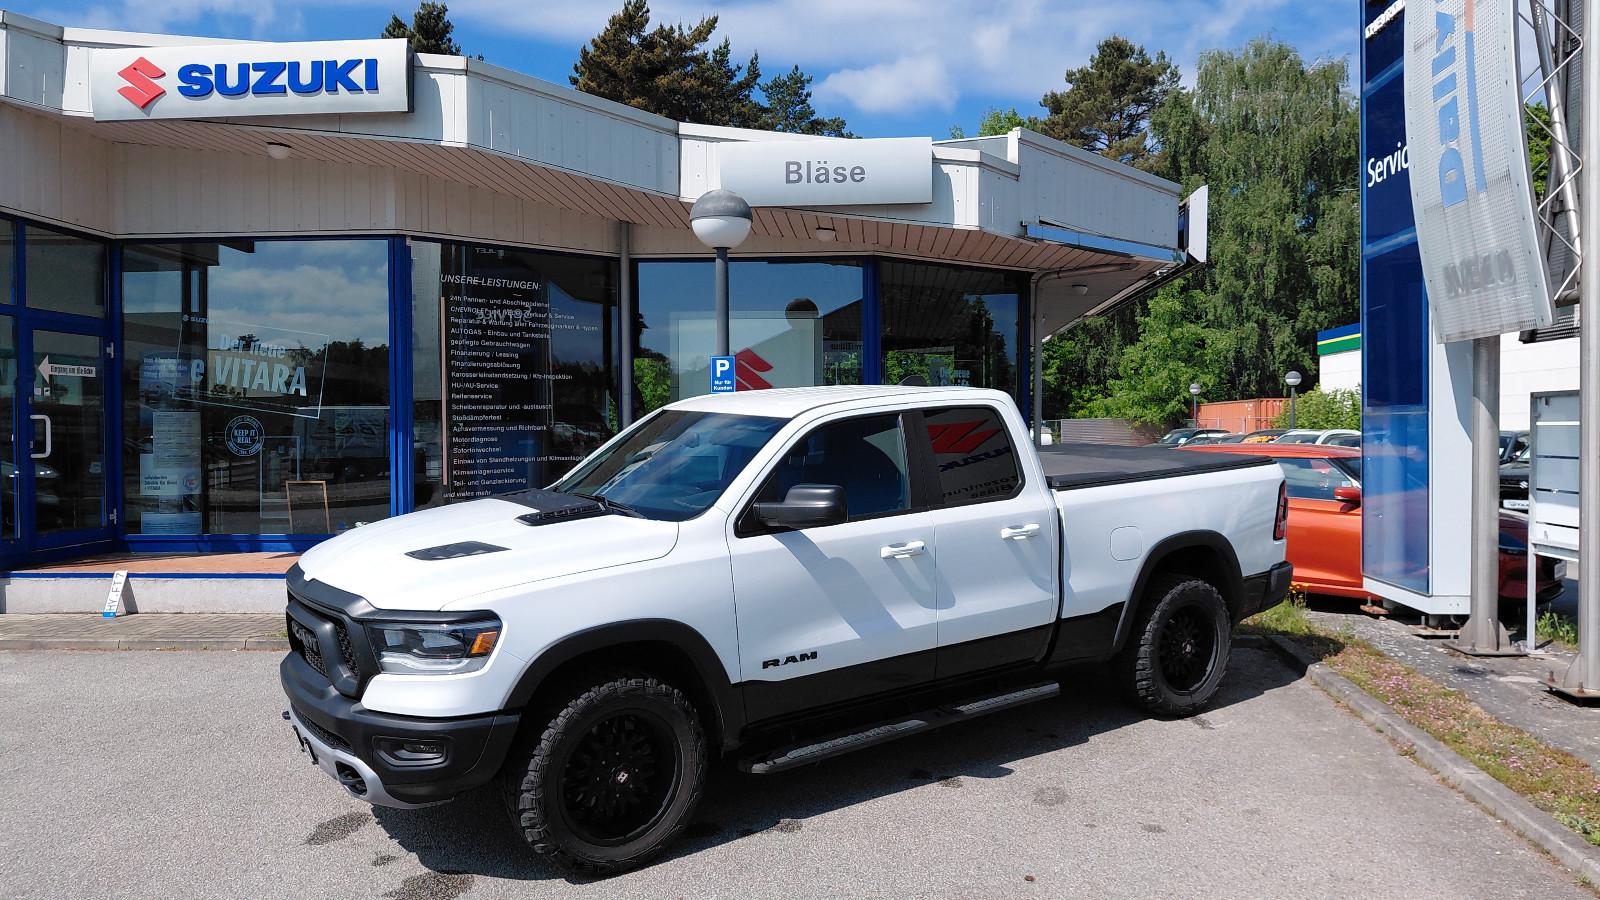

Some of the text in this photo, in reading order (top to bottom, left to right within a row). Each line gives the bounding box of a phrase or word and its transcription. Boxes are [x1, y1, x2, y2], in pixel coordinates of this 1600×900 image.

[177, 58, 379, 97] SUZUKI
[785, 160, 866, 185] Bläse
[1367, 141, 1410, 188] Servic
[440, 273, 542, 291] UNSERE LEISTUNGEN:
[450, 328, 482, 336] AUTOGAS
[249, 342, 286, 359] neue
[480, 340, 531, 349] Gebrauchtwagen
[450, 350, 491, 358] Finanzierung
[495, 351, 519, 359] Leasing
[191, 359, 205, 382] e
[214, 355, 308, 397] VITARA
[716, 359, 730, 378] P
[234, 429, 249, 437] KEEP
[518, 424, 548, 432] Richtbank
[452, 436, 498, 444] Motordiagnose
[762, 650, 818, 669] RAM
